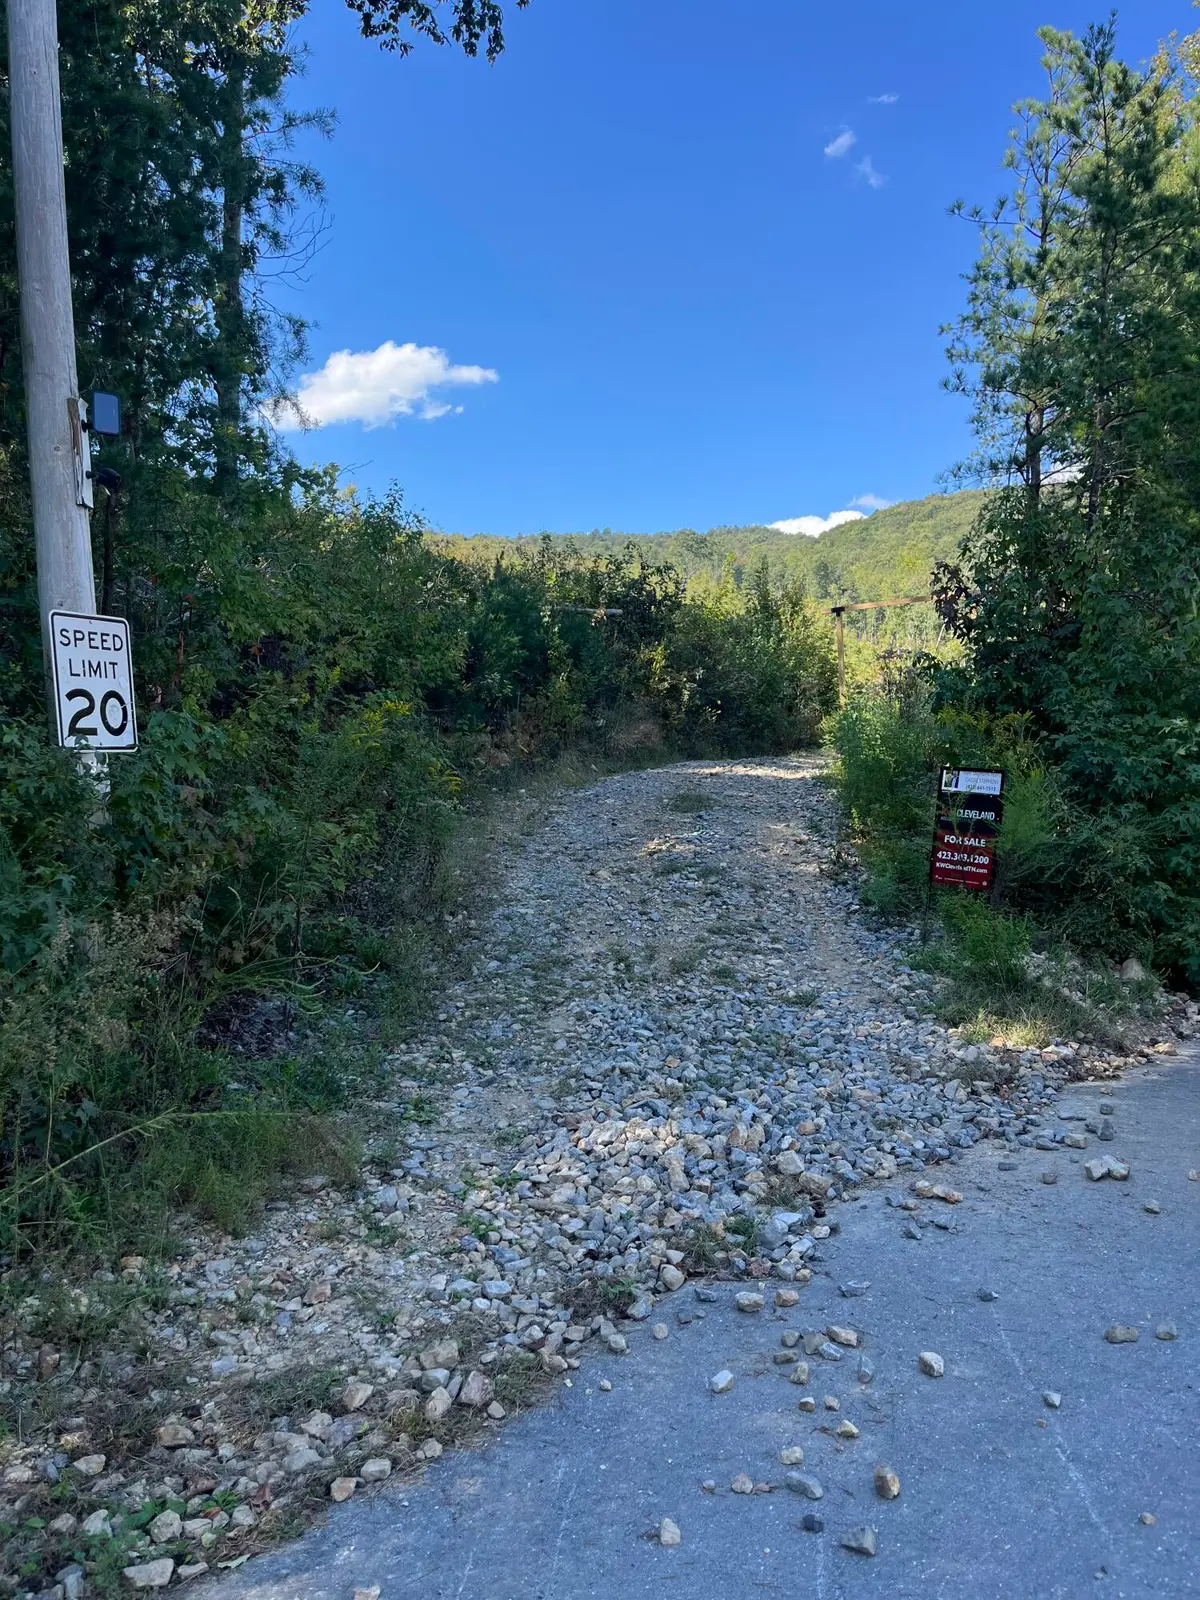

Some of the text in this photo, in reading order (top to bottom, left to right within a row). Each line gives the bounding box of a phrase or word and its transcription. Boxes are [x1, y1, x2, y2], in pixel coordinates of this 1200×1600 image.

[59, 628, 123, 652] SPEED
[68, 658, 118, 679] LIMIT
[65, 688, 128, 737] 20
[956, 809, 995, 821] CLEVELAND
[944, 834, 986, 848] FOR SALE
